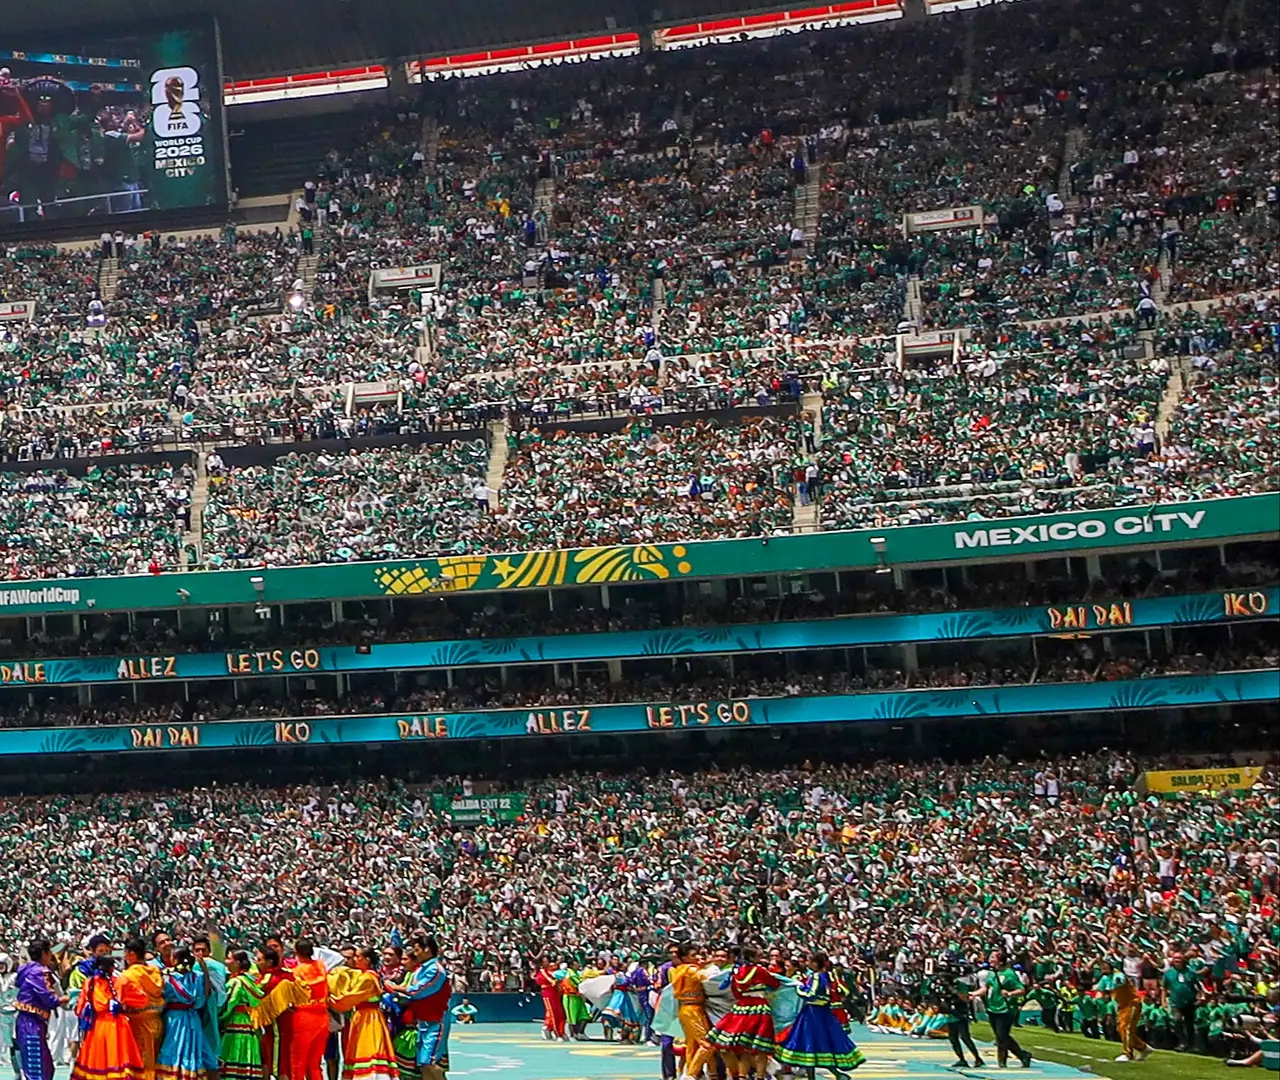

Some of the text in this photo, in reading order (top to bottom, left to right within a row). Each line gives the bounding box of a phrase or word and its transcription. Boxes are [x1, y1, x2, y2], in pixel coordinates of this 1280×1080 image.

[168, 123, 188, 131] FIFA
[155, 137, 202, 148] WORLD CUP
[155, 145, 203, 159] 2026
[155, 156, 205, 169] MEXICO
[165, 168, 195, 178] CITY
[954, 510, 1206, 549] MEXICO CITY
[1224, 591, 1268, 616] IKO
[1047, 601, 1132, 629] DAI DAI
[117, 656, 177, 680] ALLEZ
[226, 649, 319, 673] LET'S GO
[1, 663, 45, 684] DALE
[526, 710, 590, 734] ALLEZ
[646, 701, 750, 729] LET'S GO
[131, 726, 198, 747] DAI DAI
[274, 721, 310, 743] IKO
[397, 717, 448, 740] DALE
[481, 798, 497, 809] EXIT
